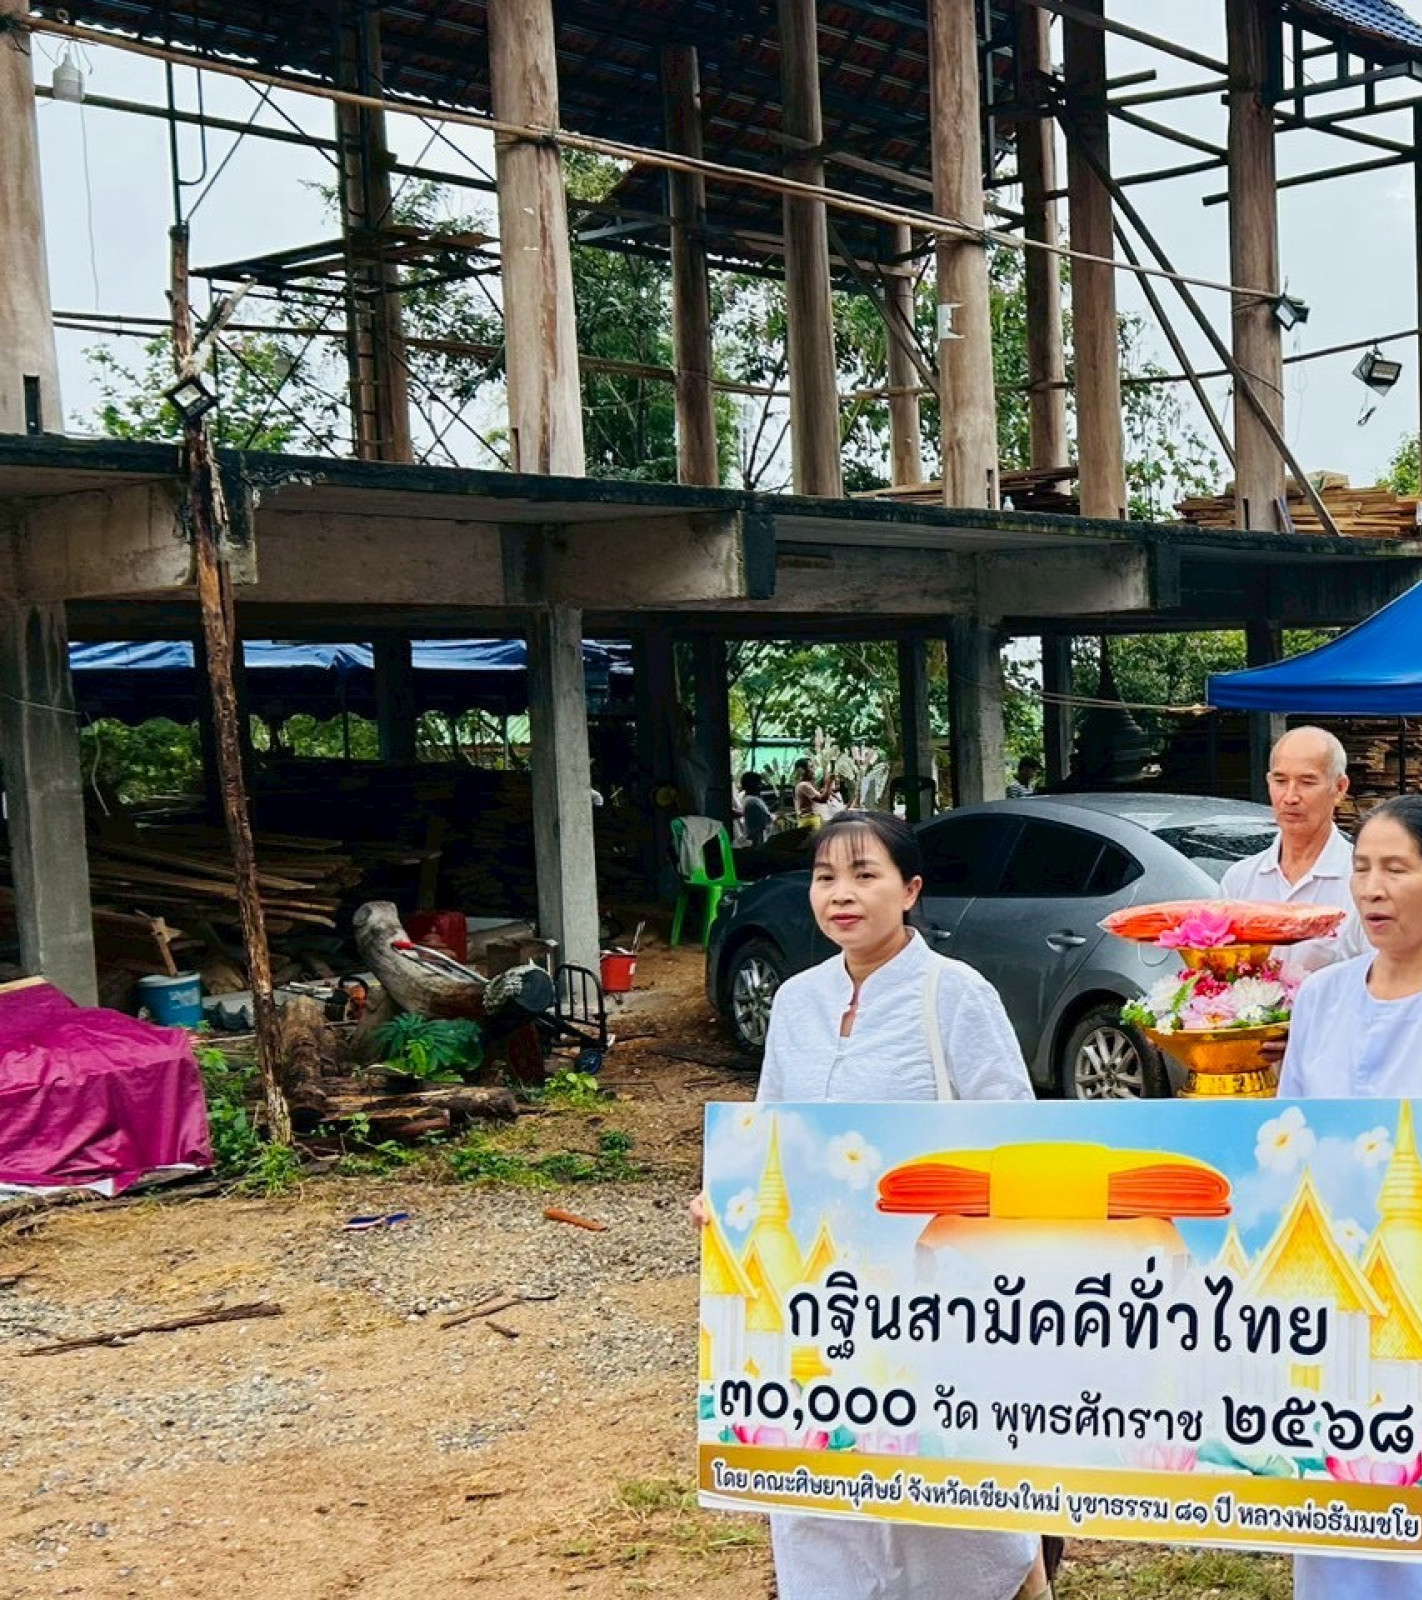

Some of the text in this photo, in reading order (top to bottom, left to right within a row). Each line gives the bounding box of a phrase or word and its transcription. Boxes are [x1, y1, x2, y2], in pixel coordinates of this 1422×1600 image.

[788, 1256, 1329, 1360] กฐินสามัคคีทั่วไทย
[719, 1379, 1415, 1454] ๓๐,๐๐๐ วัด พุทธศักราช ๒๕๖๘
[713, 1460, 1420, 1539] โดย คณะศิษยานุศิษย์ จังหวัดเชียงใหม่ บูชาธรรม ๘๑ ปี หลวงพ่อธัมมชโย
